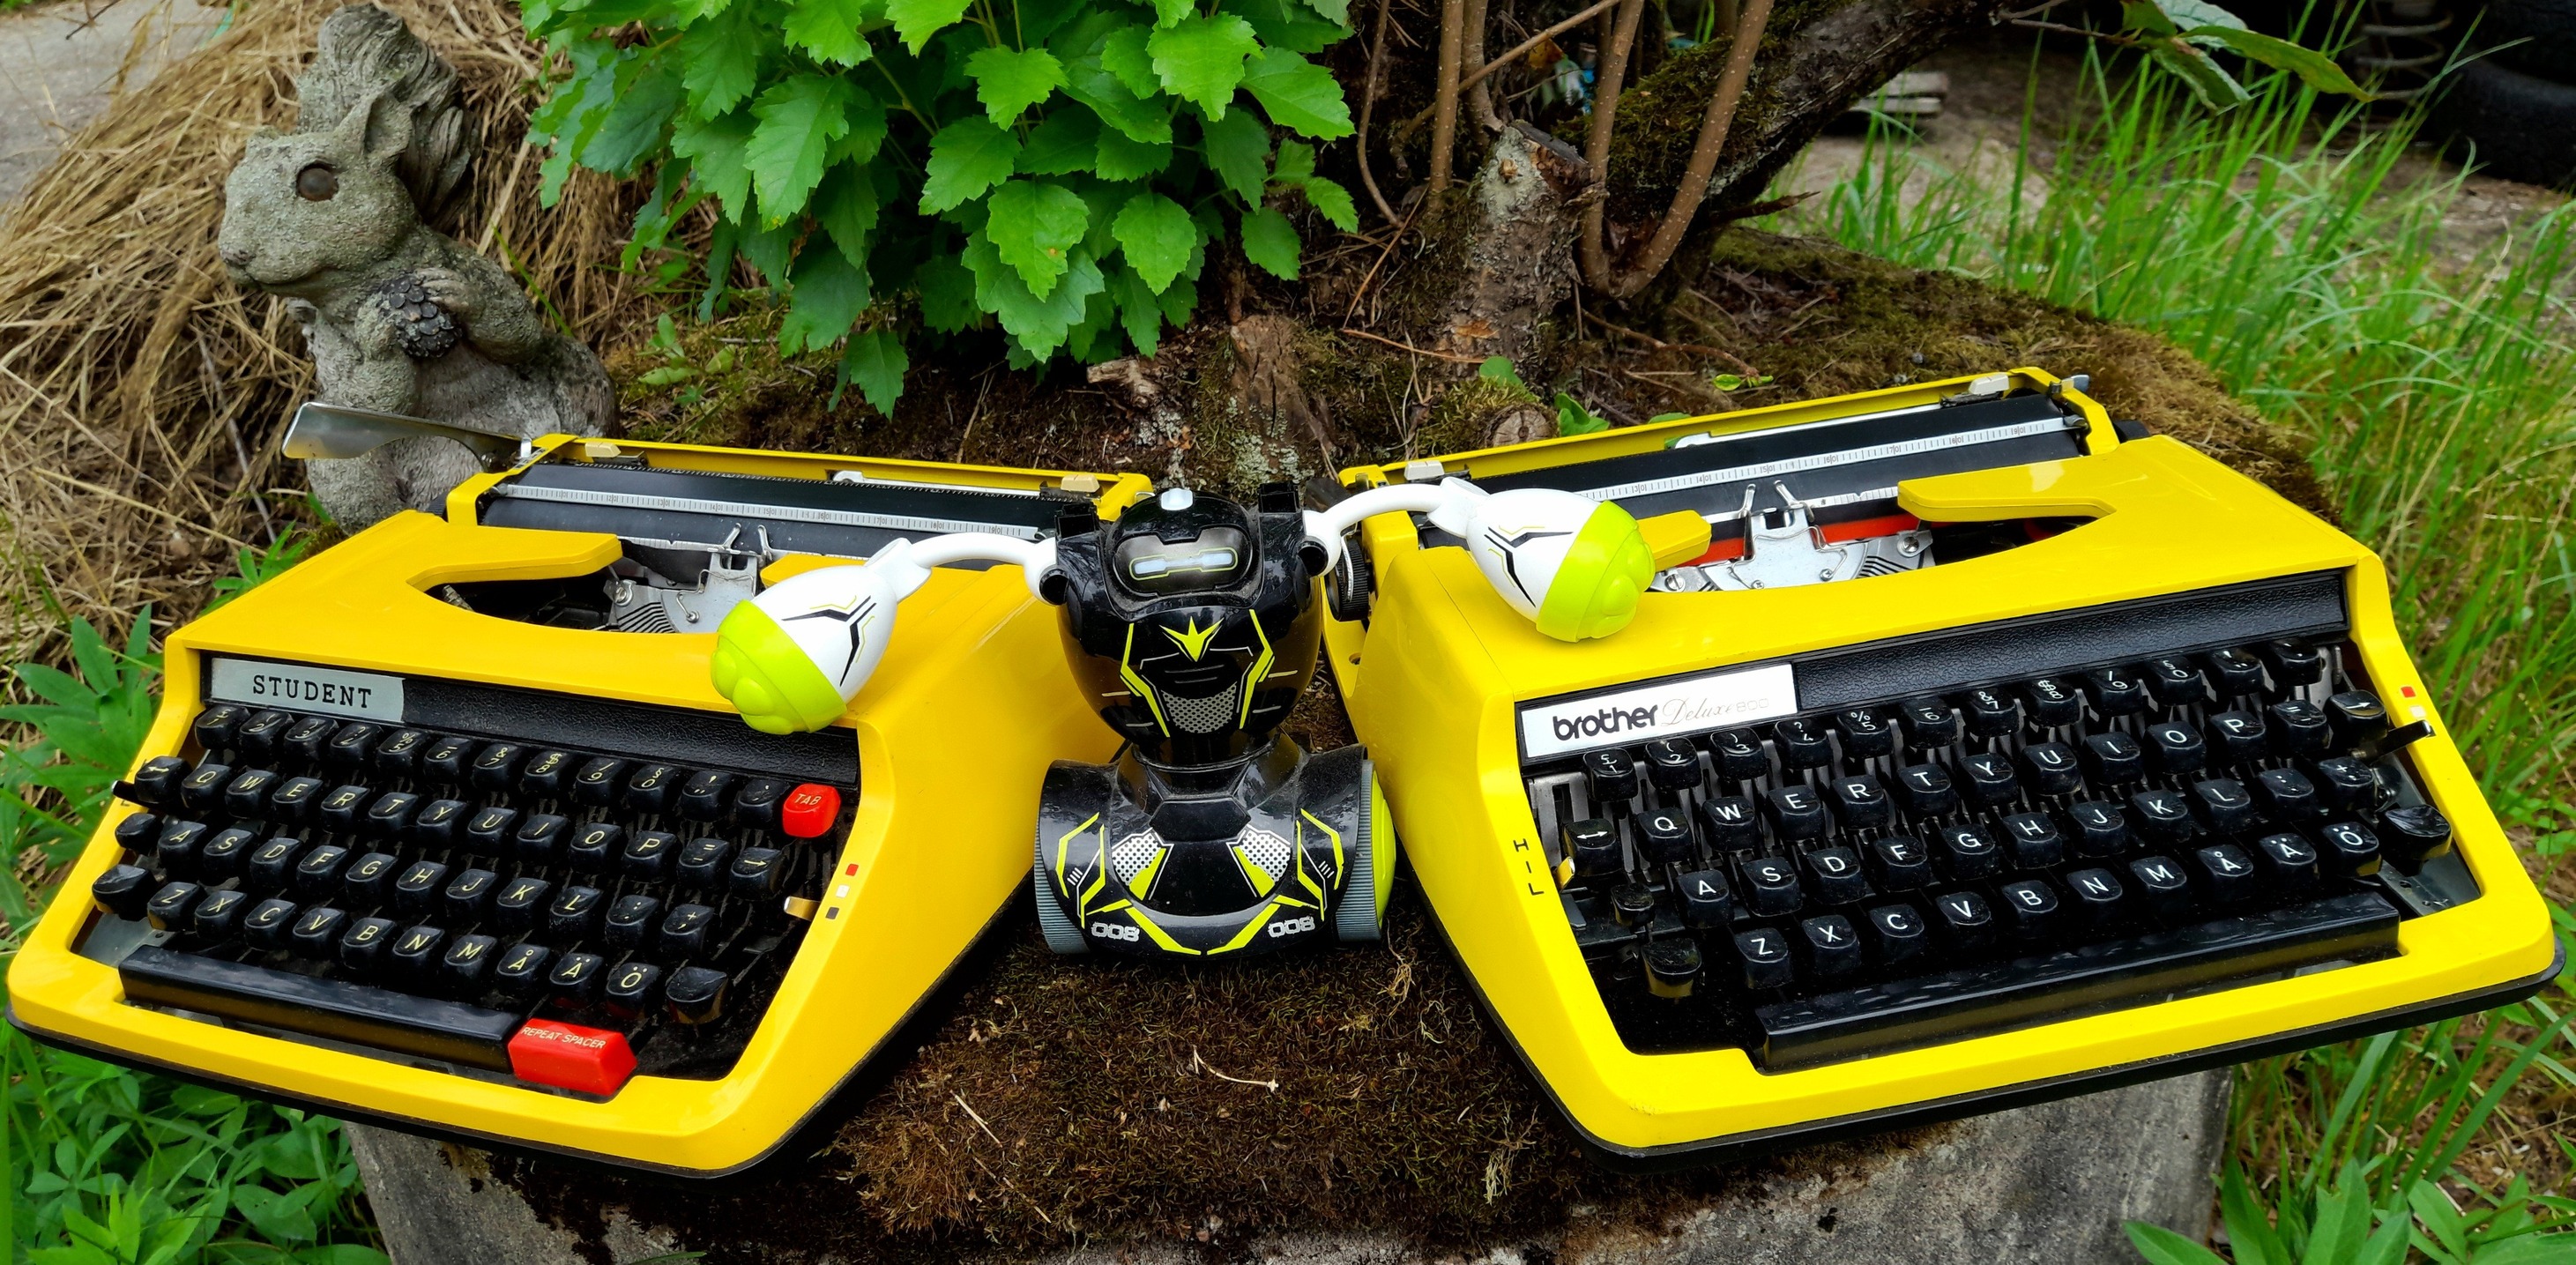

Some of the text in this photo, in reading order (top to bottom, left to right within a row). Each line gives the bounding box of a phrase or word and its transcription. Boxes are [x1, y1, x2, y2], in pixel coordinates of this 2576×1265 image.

[253, 675, 372, 709] STUDENT
[2111, 681, 2128, 689] 9
[2049, 690, 2064, 699] 8
[1552, 704, 1658, 741] brother
[1660, 697, 1735, 727] Deluxe
[1925, 711, 1939, 720] 6
[1861, 721, 1876, 731] 5
[2223, 719, 2244, 733] P
[2165, 730, 2187, 743] O
[2107, 741, 2121, 754] I
[2039, 750, 2061, 764] U
[536, 764, 550, 773] 8
[587, 771, 603, 781] 9
[1975, 762, 1995, 777] Y
[196, 770, 217, 783] Q
[239, 776, 265, 790] W
[1913, 772, 1932, 786] T
[287, 783, 309, 797] E
[1848, 784, 1871, 799] R
[2211, 788, 2235, 801] L
[332, 792, 355, 806] R
[384, 799, 405, 814] T
[794, 792, 823, 806] TAB
[1785, 793, 1807, 808] E
[434, 807, 453, 821] Y
[1716, 804, 1742, 821] W
[2148, 800, 2174, 815] K
[482, 815, 503, 829] U
[1654, 816, 1678, 831] Q
[2093, 809, 2108, 824] J
[533, 822, 549, 836] I
[2019, 820, 2044, 836] H
[169, 830, 191, 843] A
[218, 837, 237, 850] S
[585, 830, 605, 845] O
[1958, 834, 1982, 847] G
[2333, 826, 2363, 846] Ö
[264, 845, 286, 858] D
[637, 838, 660, 852] P
[1890, 845, 1908, 860] F
[2271, 837, 2304, 858] Ä
[309, 852, 334, 867] F
[1823, 857, 1845, 872] D
[2215, 851, 2242, 872] Å
[361, 860, 382, 875] G
[1762, 867, 1782, 882] S
[2145, 865, 2175, 882] M
[409, 868, 434, 883] H
[462, 877, 483, 891] J
[1699, 881, 1716, 896] A
[2082, 877, 2109, 894] N
[161, 889, 185, 904] Z
[510, 884, 534, 900] K
[2018, 889, 2042, 905] B
[208, 898, 233, 912] X
[564, 895, 581, 911] L
[1951, 901, 1972, 918] V
[260, 907, 280, 921] C
[309, 915, 331, 931] V
[1268, 916, 1315, 938] 008
[1887, 914, 1909, 930] C
[356, 926, 379, 941] B
[1091, 921, 1140, 941] 008
[1818, 926, 1843, 942] X
[405, 934, 430, 950] N
[1750, 938, 1773, 956] Z
[456, 942, 484, 960] M
[508, 949, 534, 971] Å
[561, 956, 591, 978] Ä
[621, 965, 648, 988] Ö
[521, 1026, 607, 1049] REPEAT SPACER
